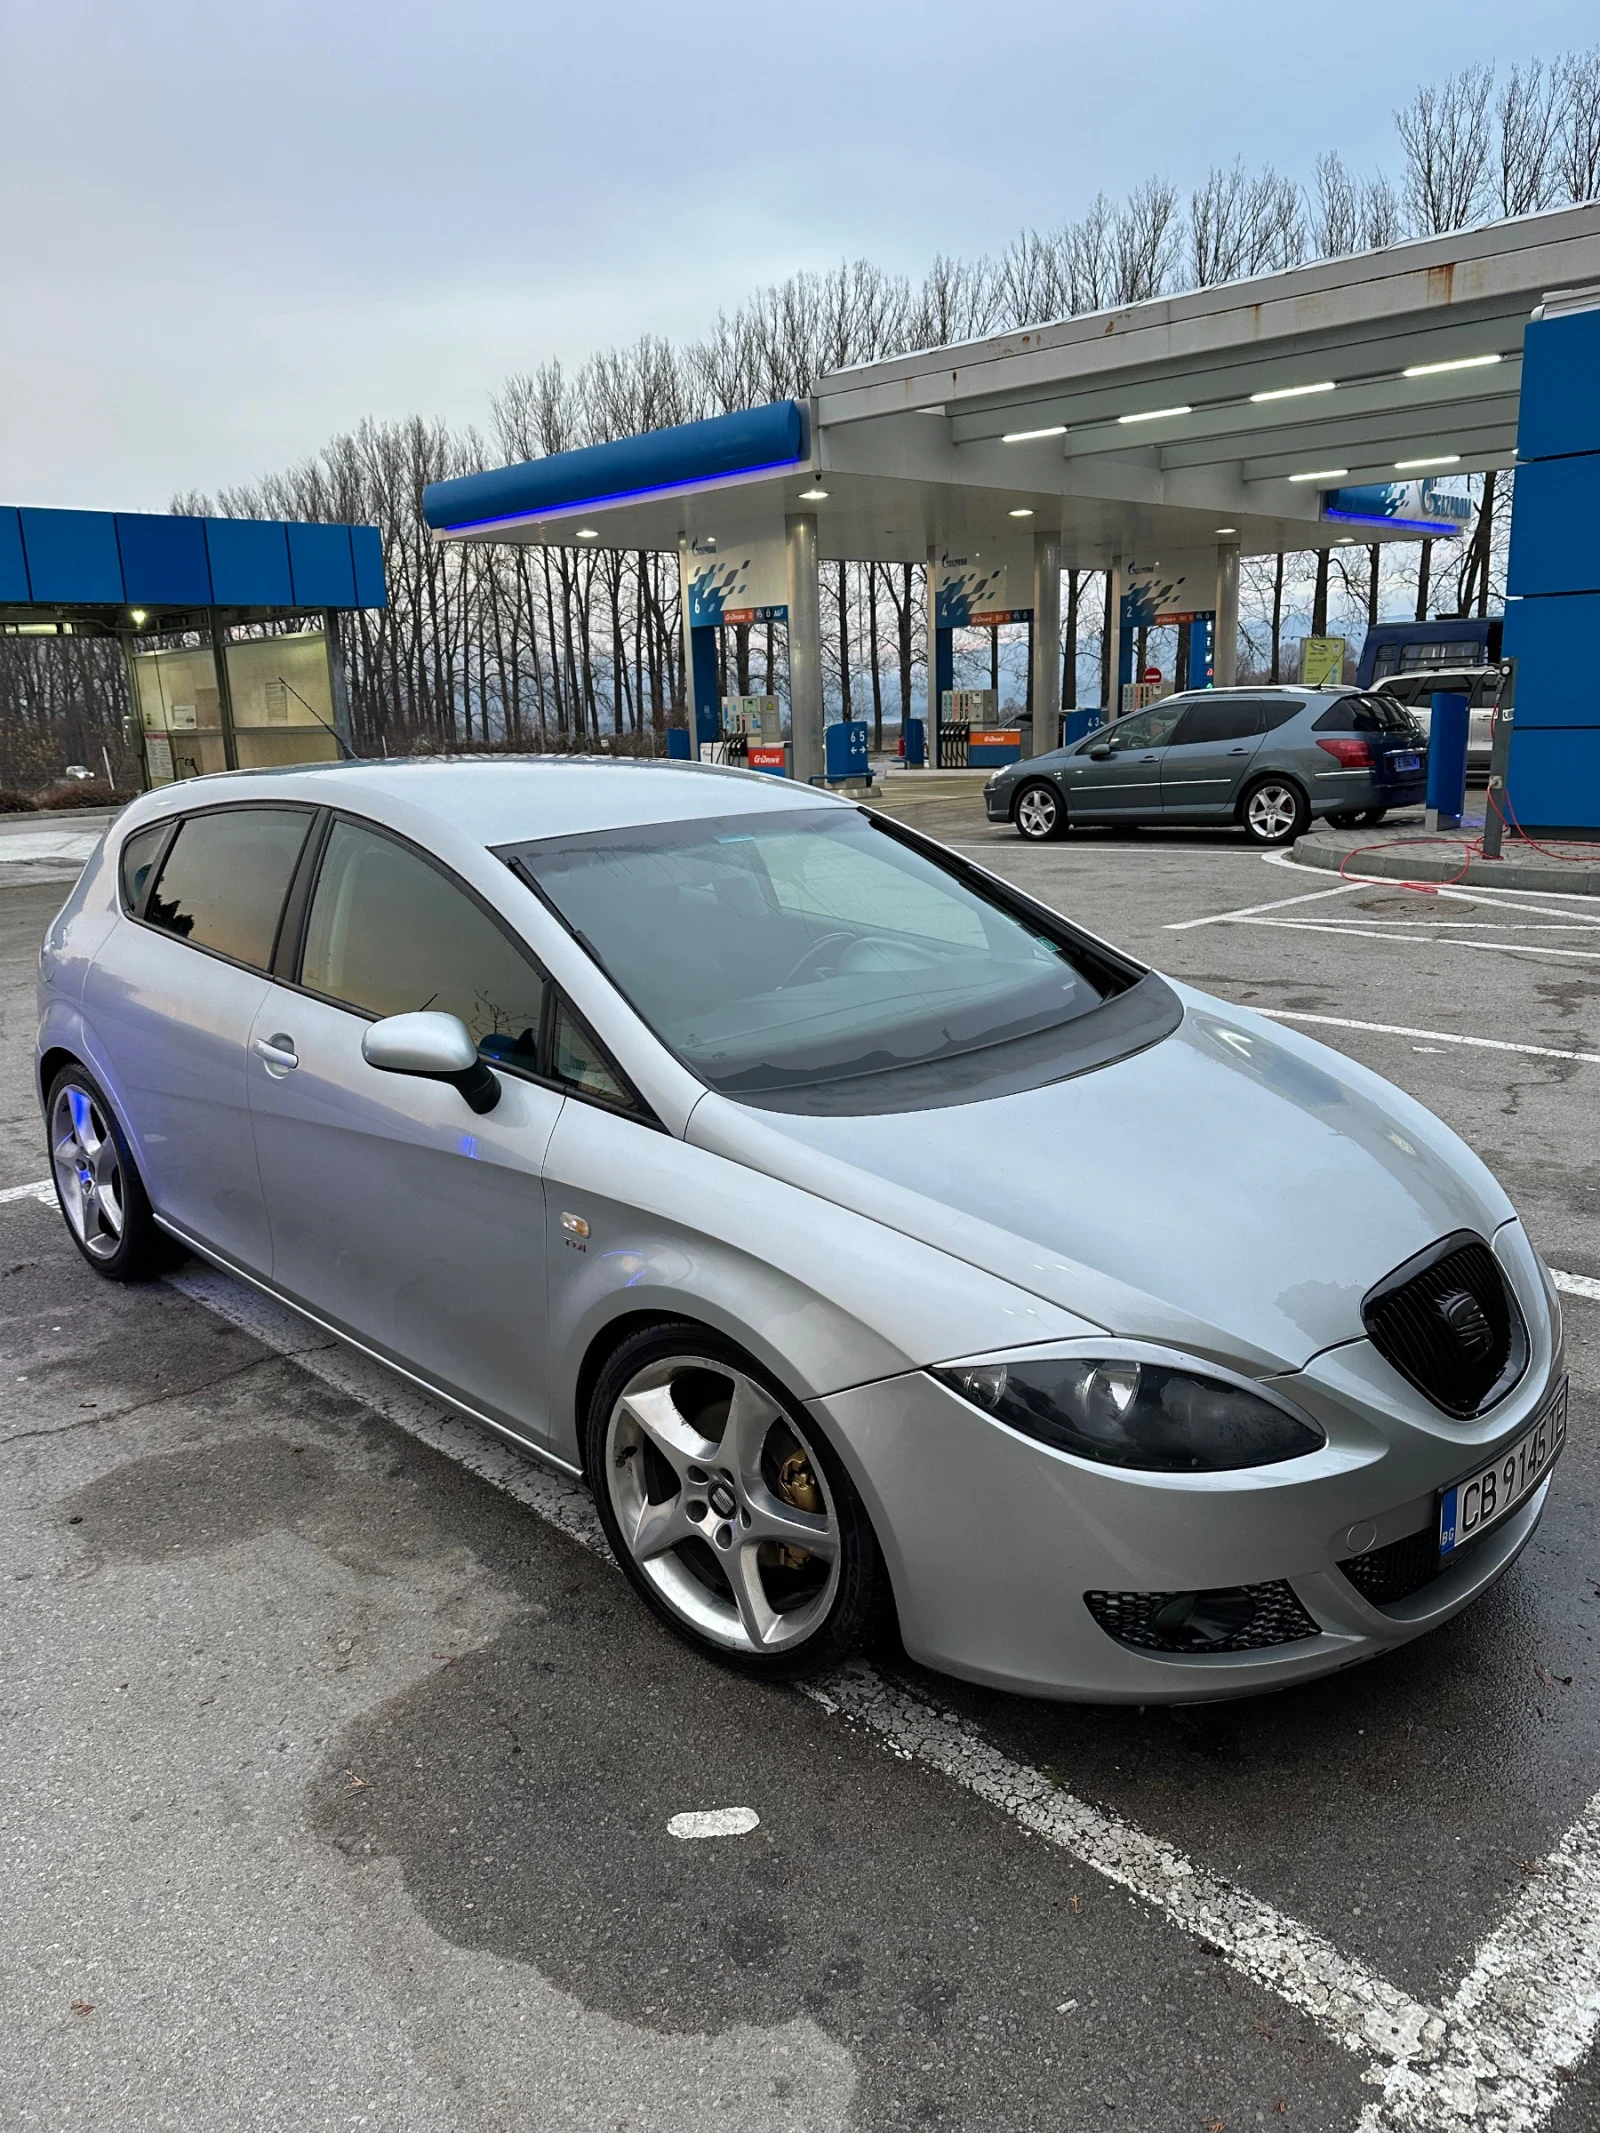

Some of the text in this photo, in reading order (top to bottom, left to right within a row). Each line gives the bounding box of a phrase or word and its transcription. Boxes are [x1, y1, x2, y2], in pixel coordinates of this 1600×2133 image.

[694, 598, 700, 614] 6
[941, 603, 948, 617] 4
[1126, 605, 1133, 618] 2
[1087, 716, 1100, 727] 4 3
[850, 730, 865, 743] 6 5
[1462, 1470, 1497, 1532] CB
[1503, 1420, 1547, 1504] 9145
[1441, 1526, 1455, 1546] BG
